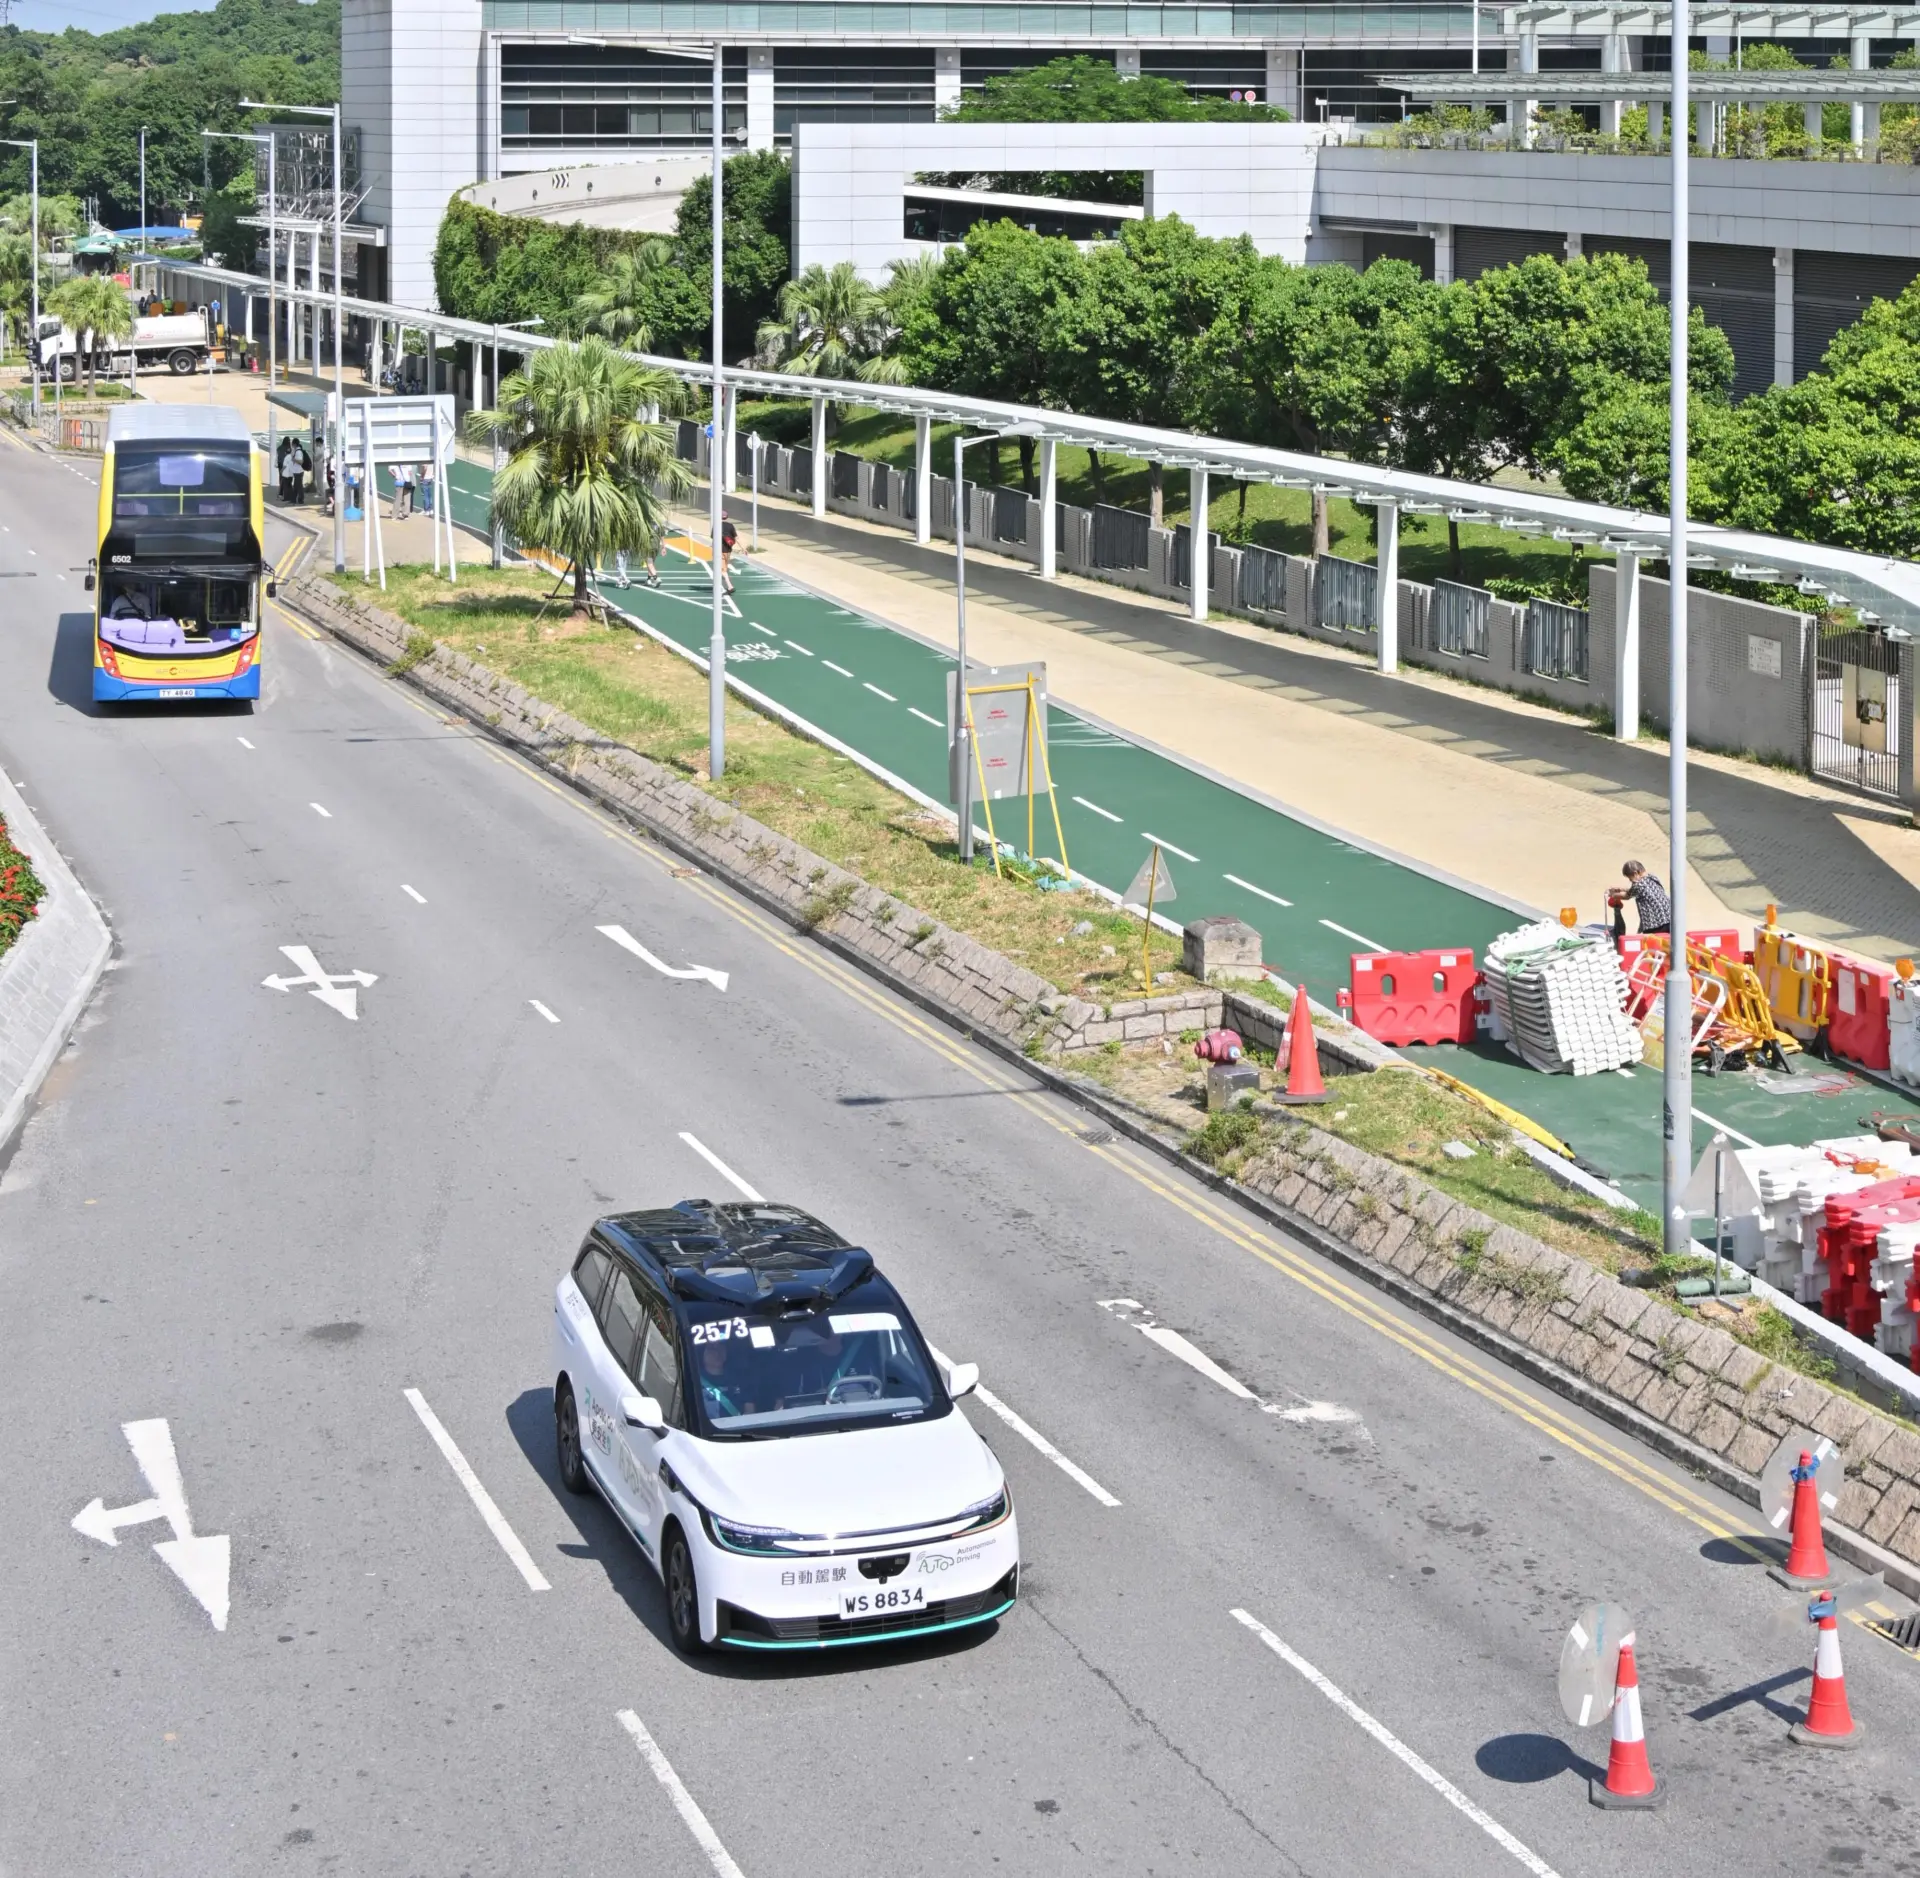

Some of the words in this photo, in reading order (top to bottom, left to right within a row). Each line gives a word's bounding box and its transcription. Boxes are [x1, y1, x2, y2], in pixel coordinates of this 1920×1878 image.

[111, 555, 132, 564] 6502
[699, 641, 771, 654] SOW
[691, 1316, 749, 1345] 2573
[957, 1538, 997, 1555] Autonomous
[956, 1552, 981, 1564] Driving
[781, 1567, 847, 1587] 自動駕駛
[845, 1595, 869, 1613] WS
[875, 1587, 924, 1609] 8834
